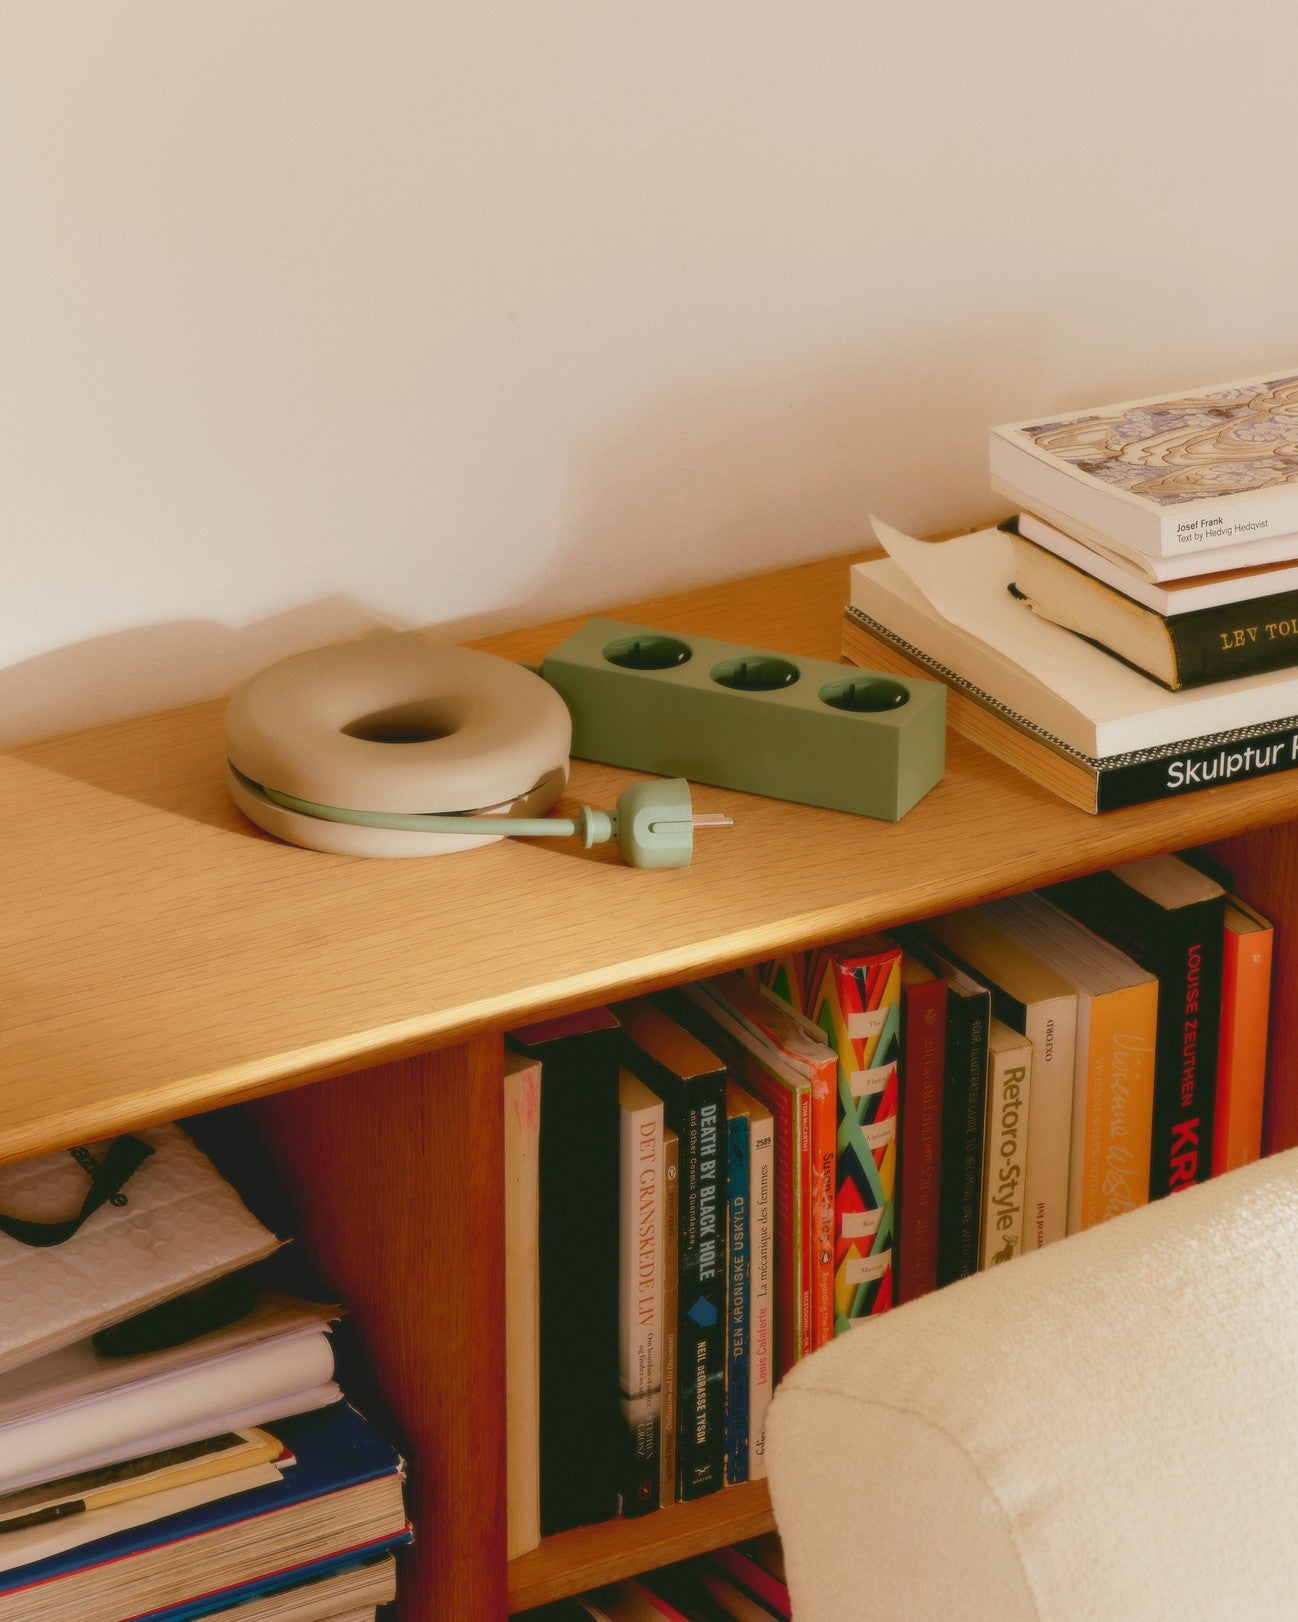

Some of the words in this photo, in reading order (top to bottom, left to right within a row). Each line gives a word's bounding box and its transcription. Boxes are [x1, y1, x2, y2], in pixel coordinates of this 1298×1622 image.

[1177, 521, 1199, 533] Josef
[1201, 517, 1223, 528] Frank
[1177, 533, 1193, 543] Text
[1194, 531, 1203, 542] by
[1206, 526, 1232, 539] Hedvig
[1234, 520, 1268, 533] Hedqvist
[1219, 626, 1258, 650] LEV
[1265, 619, 1298, 640] TOL
[1166, 743, 1285, 788] Skulptur
[1184, 944, 1202, 1014] LOUISE
[970, 1020, 982, 1044] YOUR
[1045, 1019, 1054, 1062] OXFORD
[1181, 1018, 1199, 1107] ZEUTHEN
[1093, 1057, 1105, 1115] VIVIENNE
[690, 1110, 699, 1125] and
[801, 1101, 809, 1119] TOM
[966, 1105, 977, 1134] GUIDE
[639, 1120, 657, 1162] DET
[690, 1128, 699, 1155] Other
[699, 1103, 717, 1157] DEATH
[756, 1137, 771, 1148] 2589
[800, 1120, 809, 1152] McCARTHY
[992, 1066, 1026, 1231] Retoro-Style
[1088, 1116, 1102, 1187] WESTWOOD
[690, 1158, 698, 1190] Cosmic
[699, 1159, 717, 1181] BY
[757, 1165, 769, 1206] femmes
[823, 1153, 835, 1192] Susan
[689, 1193, 698, 1244] Quandaries
[699, 1185, 717, 1238] BLACK
[733, 1196, 744, 1251] USKYLD
[757, 1208, 769, 1225] des
[1036, 1220, 1044, 1229] of
[1037, 1203, 1046, 1219] Evil
[638, 1168, 657, 1292] GRANSKEDE
[699, 1240, 717, 1282] HOLE
[757, 1226, 771, 1281] mécanique
[733, 1255, 744, 1325] KRONISKE
[757, 1283, 769, 1298] La
[820, 1272, 831, 1312] Regarding
[637, 1294, 655, 1326] LIV
[821, 1313, 830, 1326] the
[733, 1328, 744, 1356] DEN
[756, 1308, 768, 1355] Calaferte
[696, 1340, 707, 1363] NEIL
[756, 1357, 769, 1387] Louis
[695, 1413, 707, 1445] TYSON
